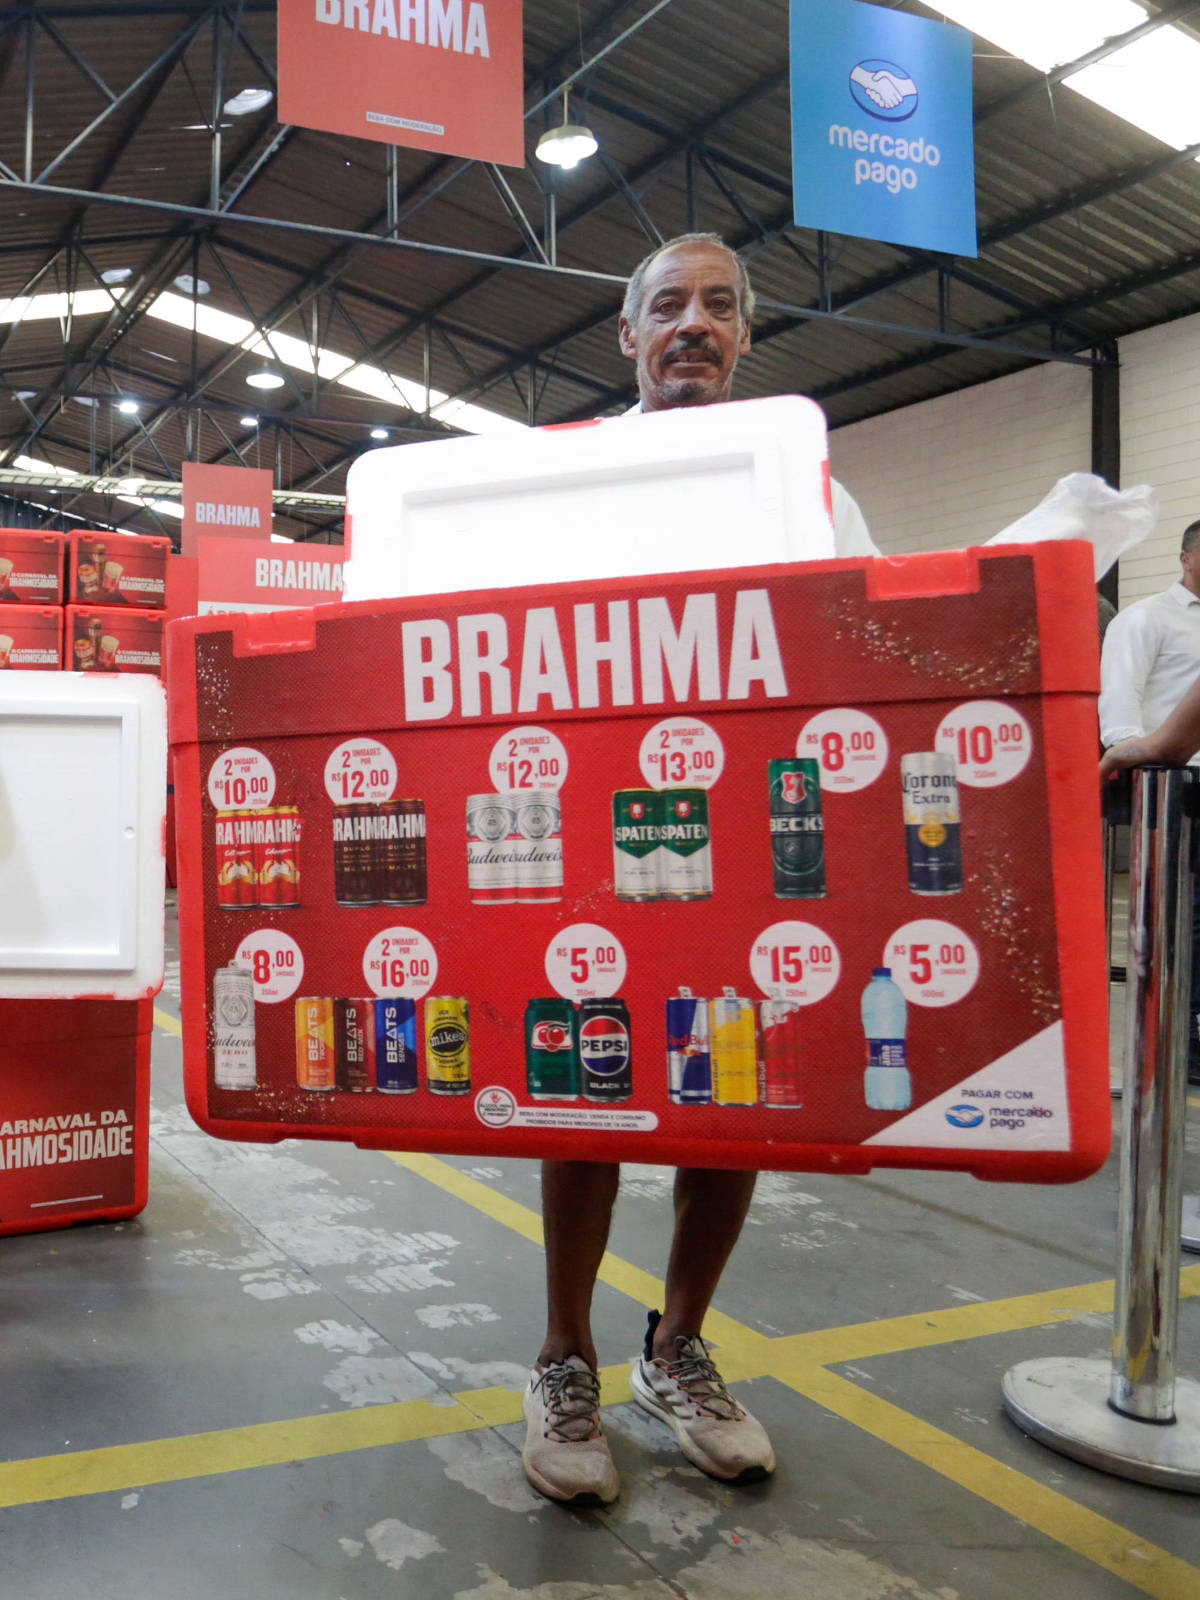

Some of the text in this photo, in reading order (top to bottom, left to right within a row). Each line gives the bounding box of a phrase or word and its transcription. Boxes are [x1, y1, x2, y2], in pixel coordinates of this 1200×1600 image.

[828, 123, 941, 167] mercado
[854, 158, 918, 194] pago
[195, 501, 262, 528] BRAHMA
[255, 558, 344, 592] BRAHMA
[401, 588, 789, 722] BRAHMA
[508, 739, 518, 757] 2
[660, 729, 670, 749] 2
[821, 731, 875, 771] 8,00
[957, 723, 1023, 765] 10,00
[224, 759, 233, 776] 2
[342, 751, 351, 768] 2
[509, 758, 560, 789] 12,00
[660, 750, 715, 782] 13,00
[224, 777, 268, 805] 10,00
[342, 769, 389, 798] 12,00
[912, 791, 952, 805] Extra
[660, 824, 708, 841] SPATEN
[381, 938, 391, 956] 2
[253, 949, 294, 984] 8,00
[381, 959, 430, 987] 16,00
[570, 946, 616, 984] 5,00
[770, 945, 832, 983] 15,00
[909, 944, 966, 984] 5,00
[307, 1007, 318, 1061] BEATS
[346, 1008, 357, 1062] BEATS
[385, 1007, 398, 1063] BEATS
[581, 1039, 628, 1053] PEPSI
[960, 1089, 1034, 1099] PAGAR COM
[100, 1109, 128, 1125] DA
[989, 1105, 1053, 1118] mercado
[990, 1118, 1026, 1130] pago
